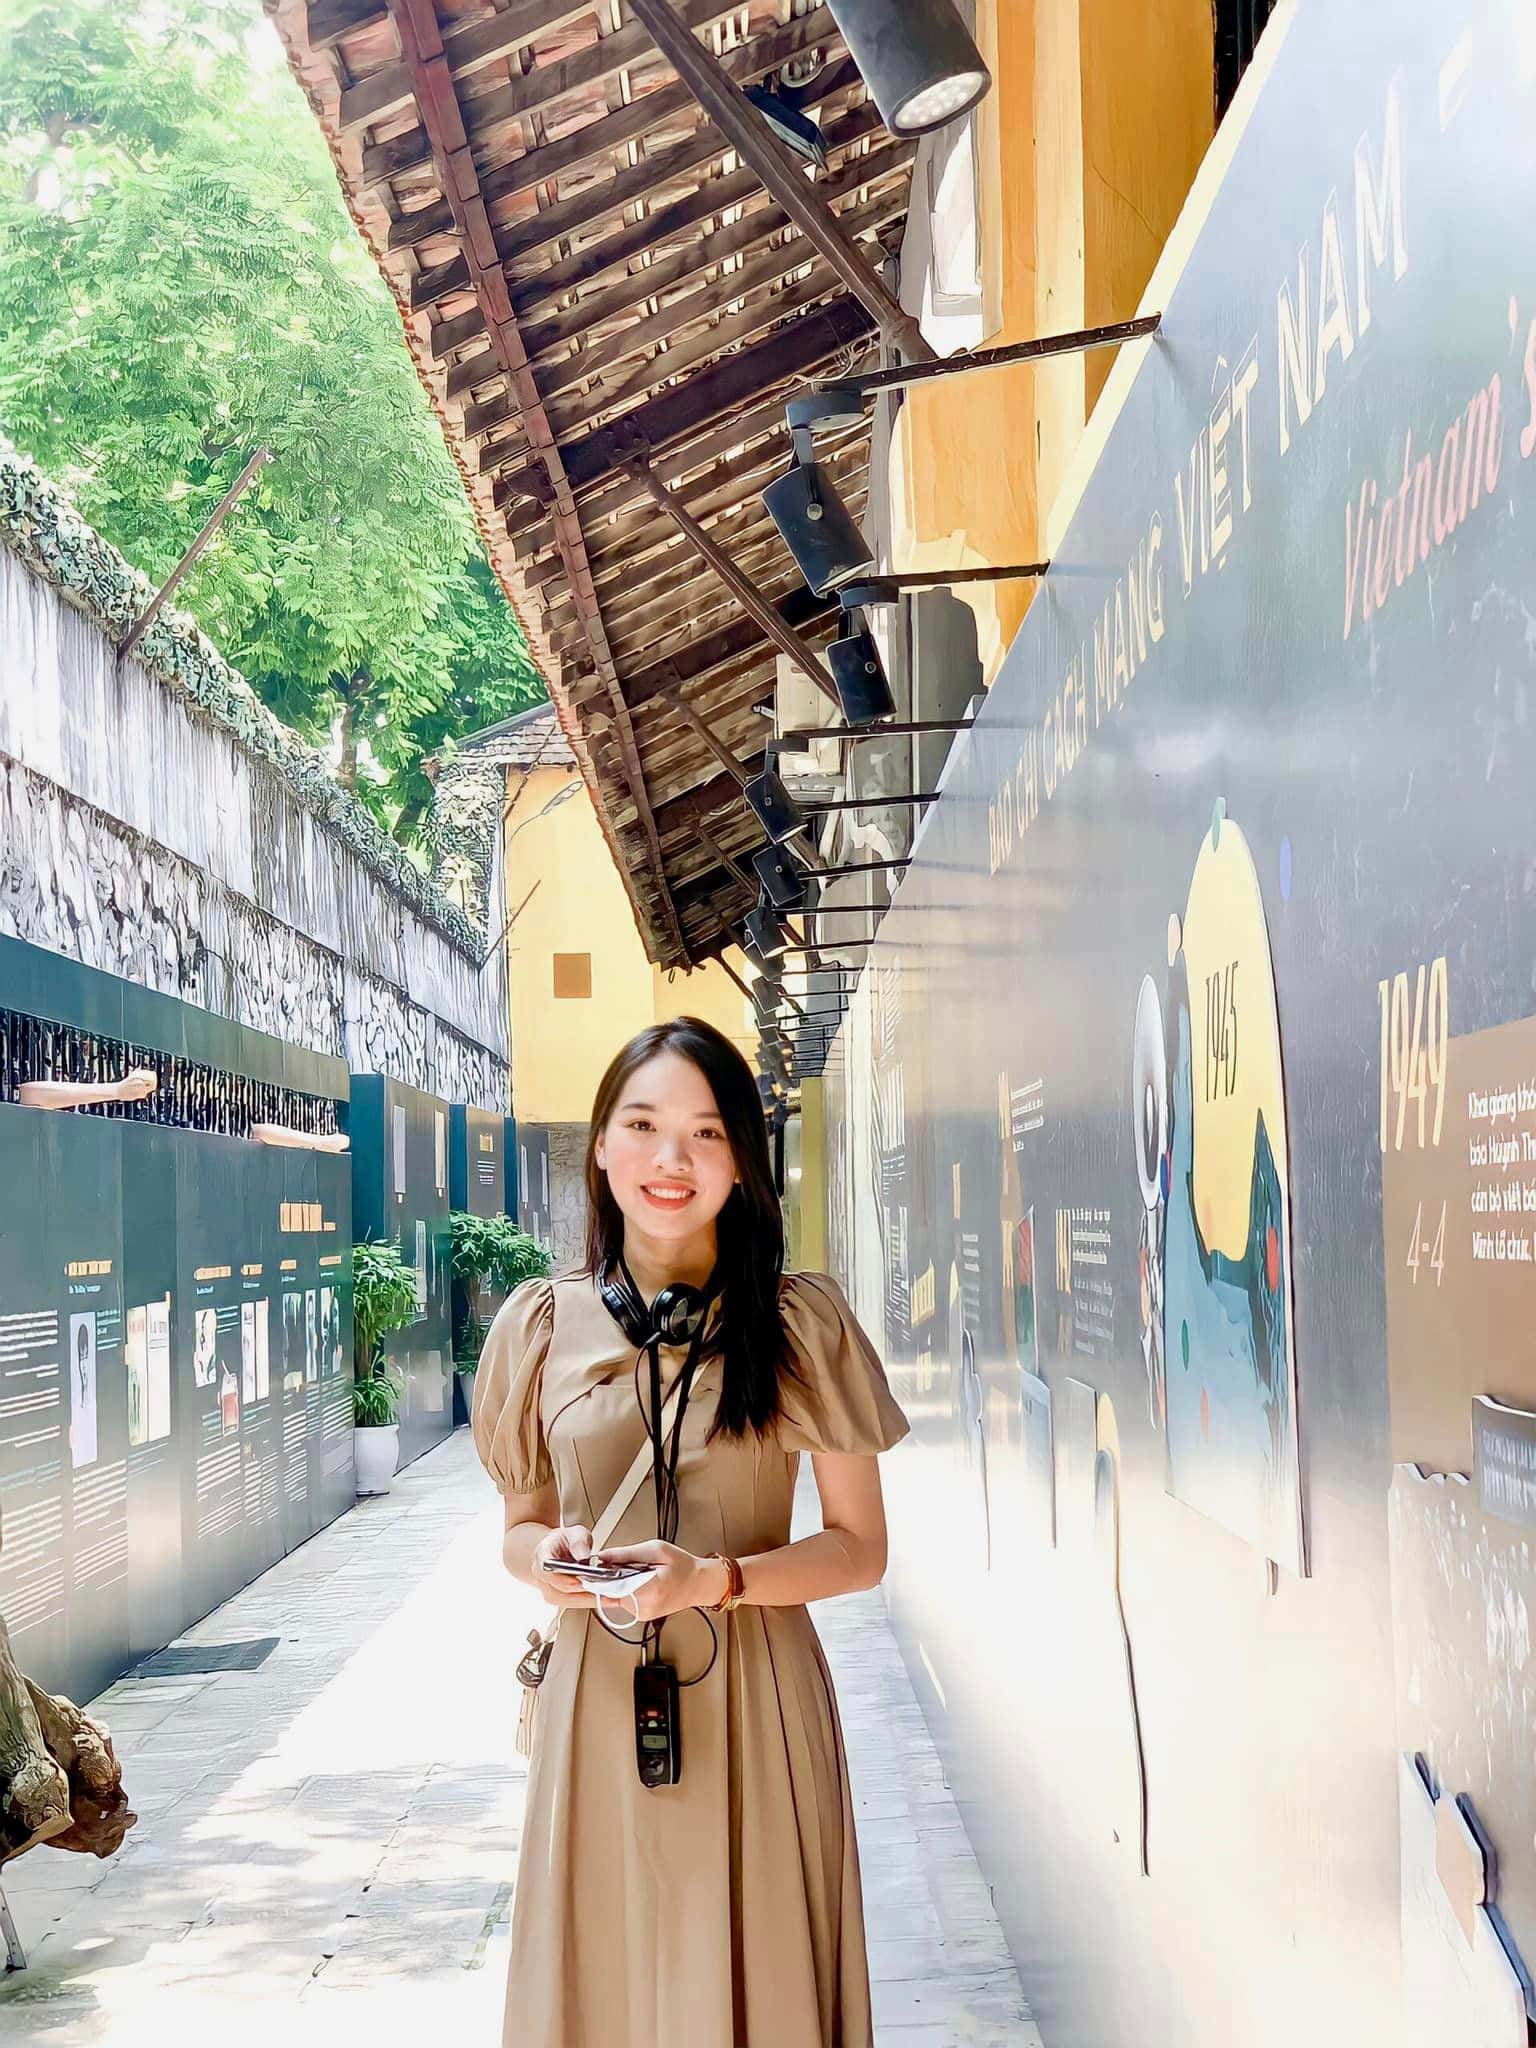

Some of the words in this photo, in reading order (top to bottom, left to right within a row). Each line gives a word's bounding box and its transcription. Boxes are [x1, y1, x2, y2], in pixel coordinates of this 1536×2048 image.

[1174, 332, 1258, 600] VIỆT
[1277, 66, 1408, 457] NAM
[1205, 961, 1239, 1103] 1945
[1378, 957, 1449, 1153] 1949
[1407, 1200, 1446, 1288] 4-4
